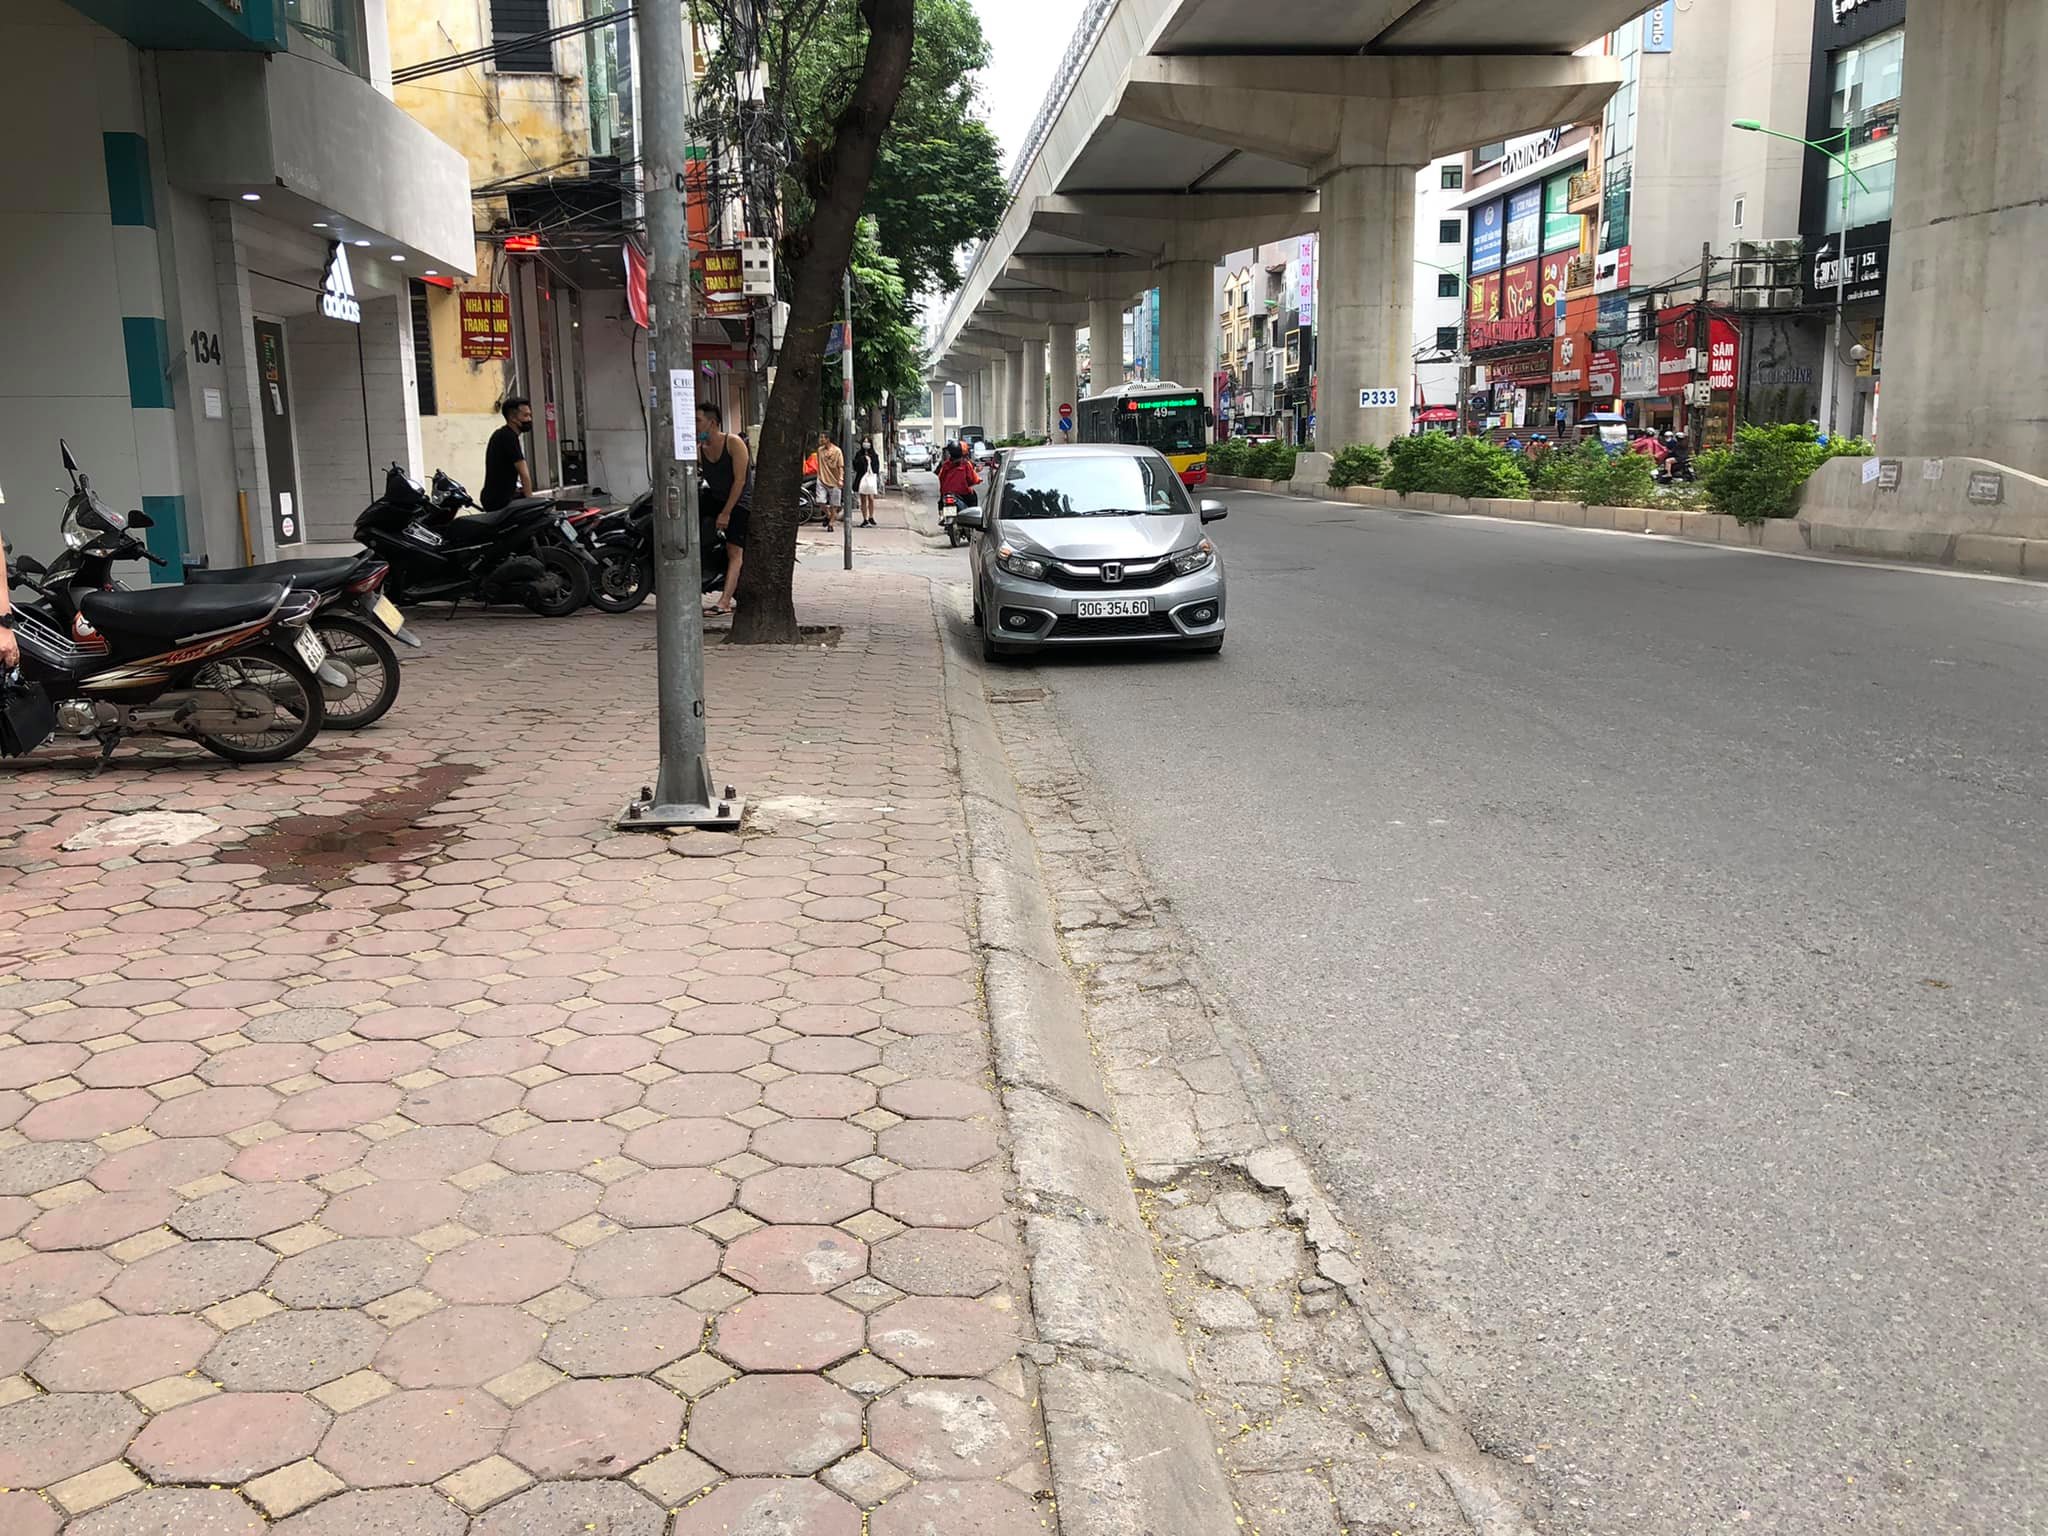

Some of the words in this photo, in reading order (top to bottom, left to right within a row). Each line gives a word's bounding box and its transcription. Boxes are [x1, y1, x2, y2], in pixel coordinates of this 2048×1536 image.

[1501, 138, 1547, 176] GAMING
[1862, 252, 1876, 266] 151
[705, 275, 728, 290] TRANG
[323, 292, 361, 323] adidas
[465, 296, 482, 313] NHÀ
[464, 318, 489, 332] TRANG
[190, 330, 221, 365] 134
[1712, 357, 1732, 371] HÀN
[1709, 371, 1734, 389] QUỐC
[1361, 390, 1396, 405] P333
[1154, 407, 1168, 417] 49
[1079, 600, 1147, 616] 30G-354.60
